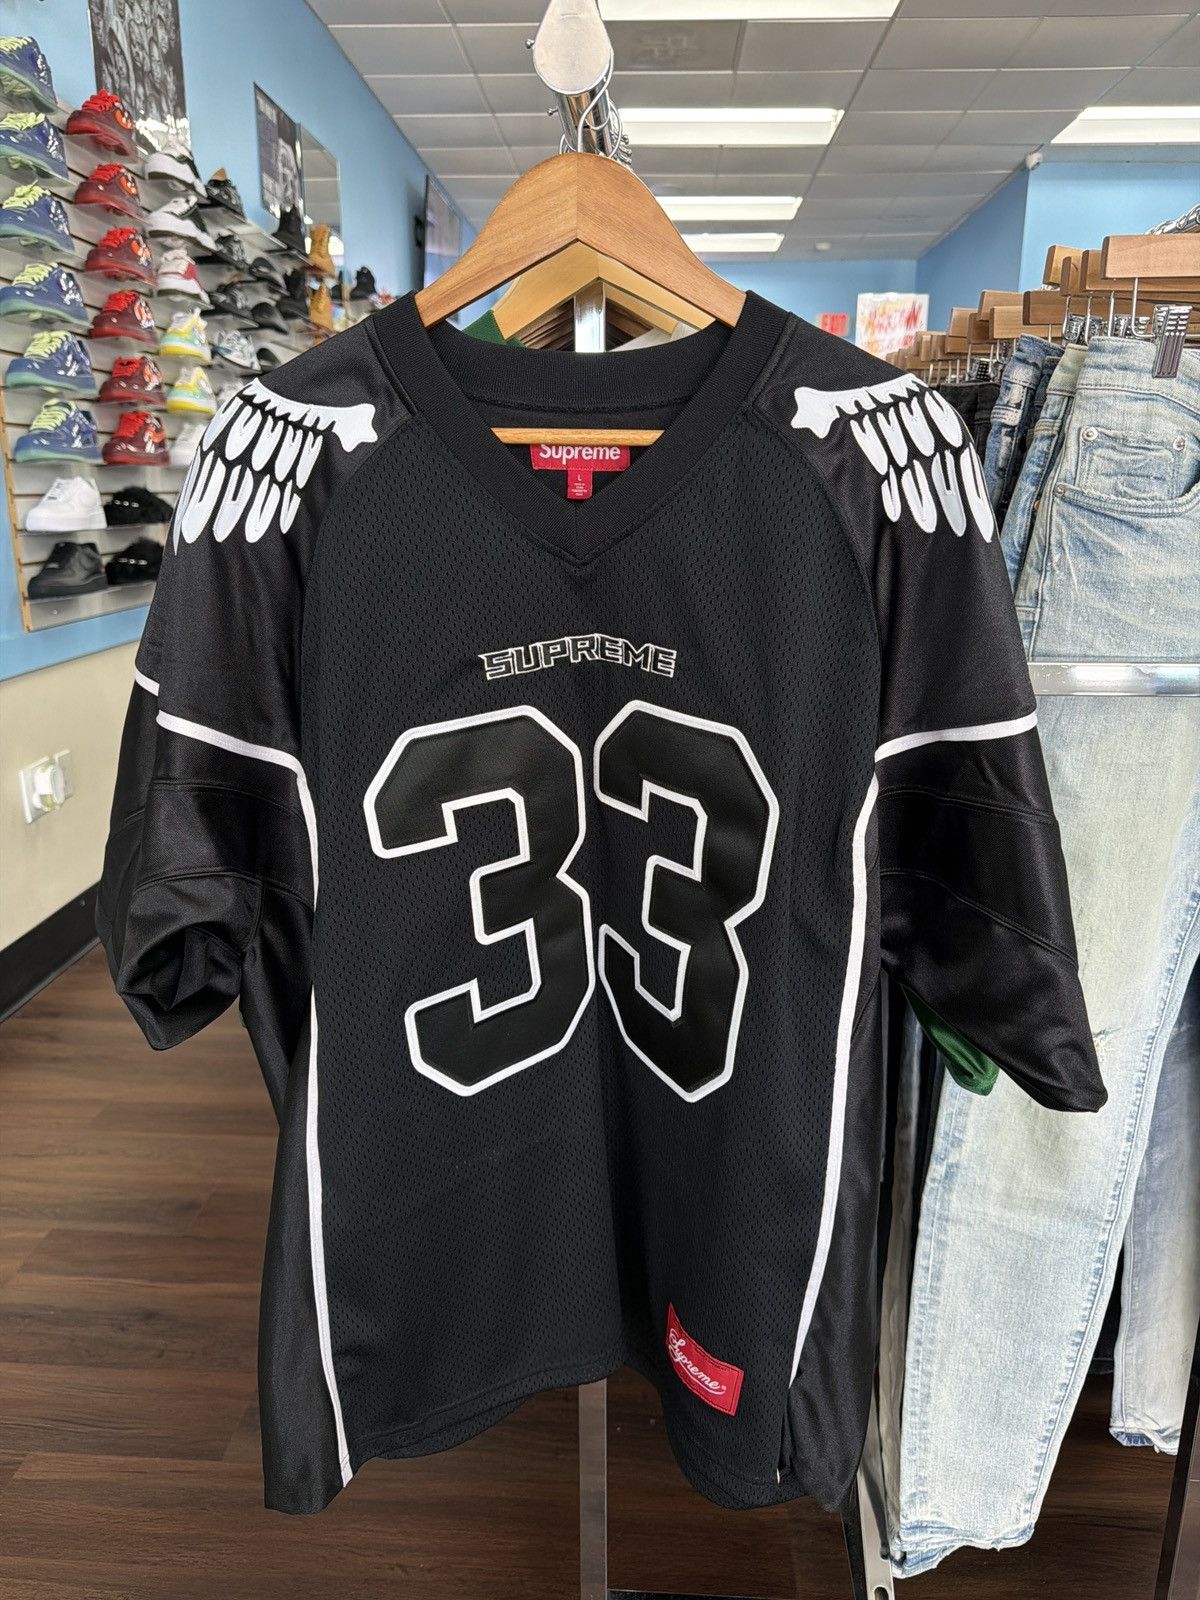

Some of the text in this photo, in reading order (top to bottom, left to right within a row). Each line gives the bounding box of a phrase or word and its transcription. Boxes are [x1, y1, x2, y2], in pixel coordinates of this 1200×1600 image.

[539, 444, 621, 465] Supreme
[478, 633, 677, 680] SUPREME
[363, 700, 779, 1103] 33
[668, 1328, 726, 1395] Supreme
